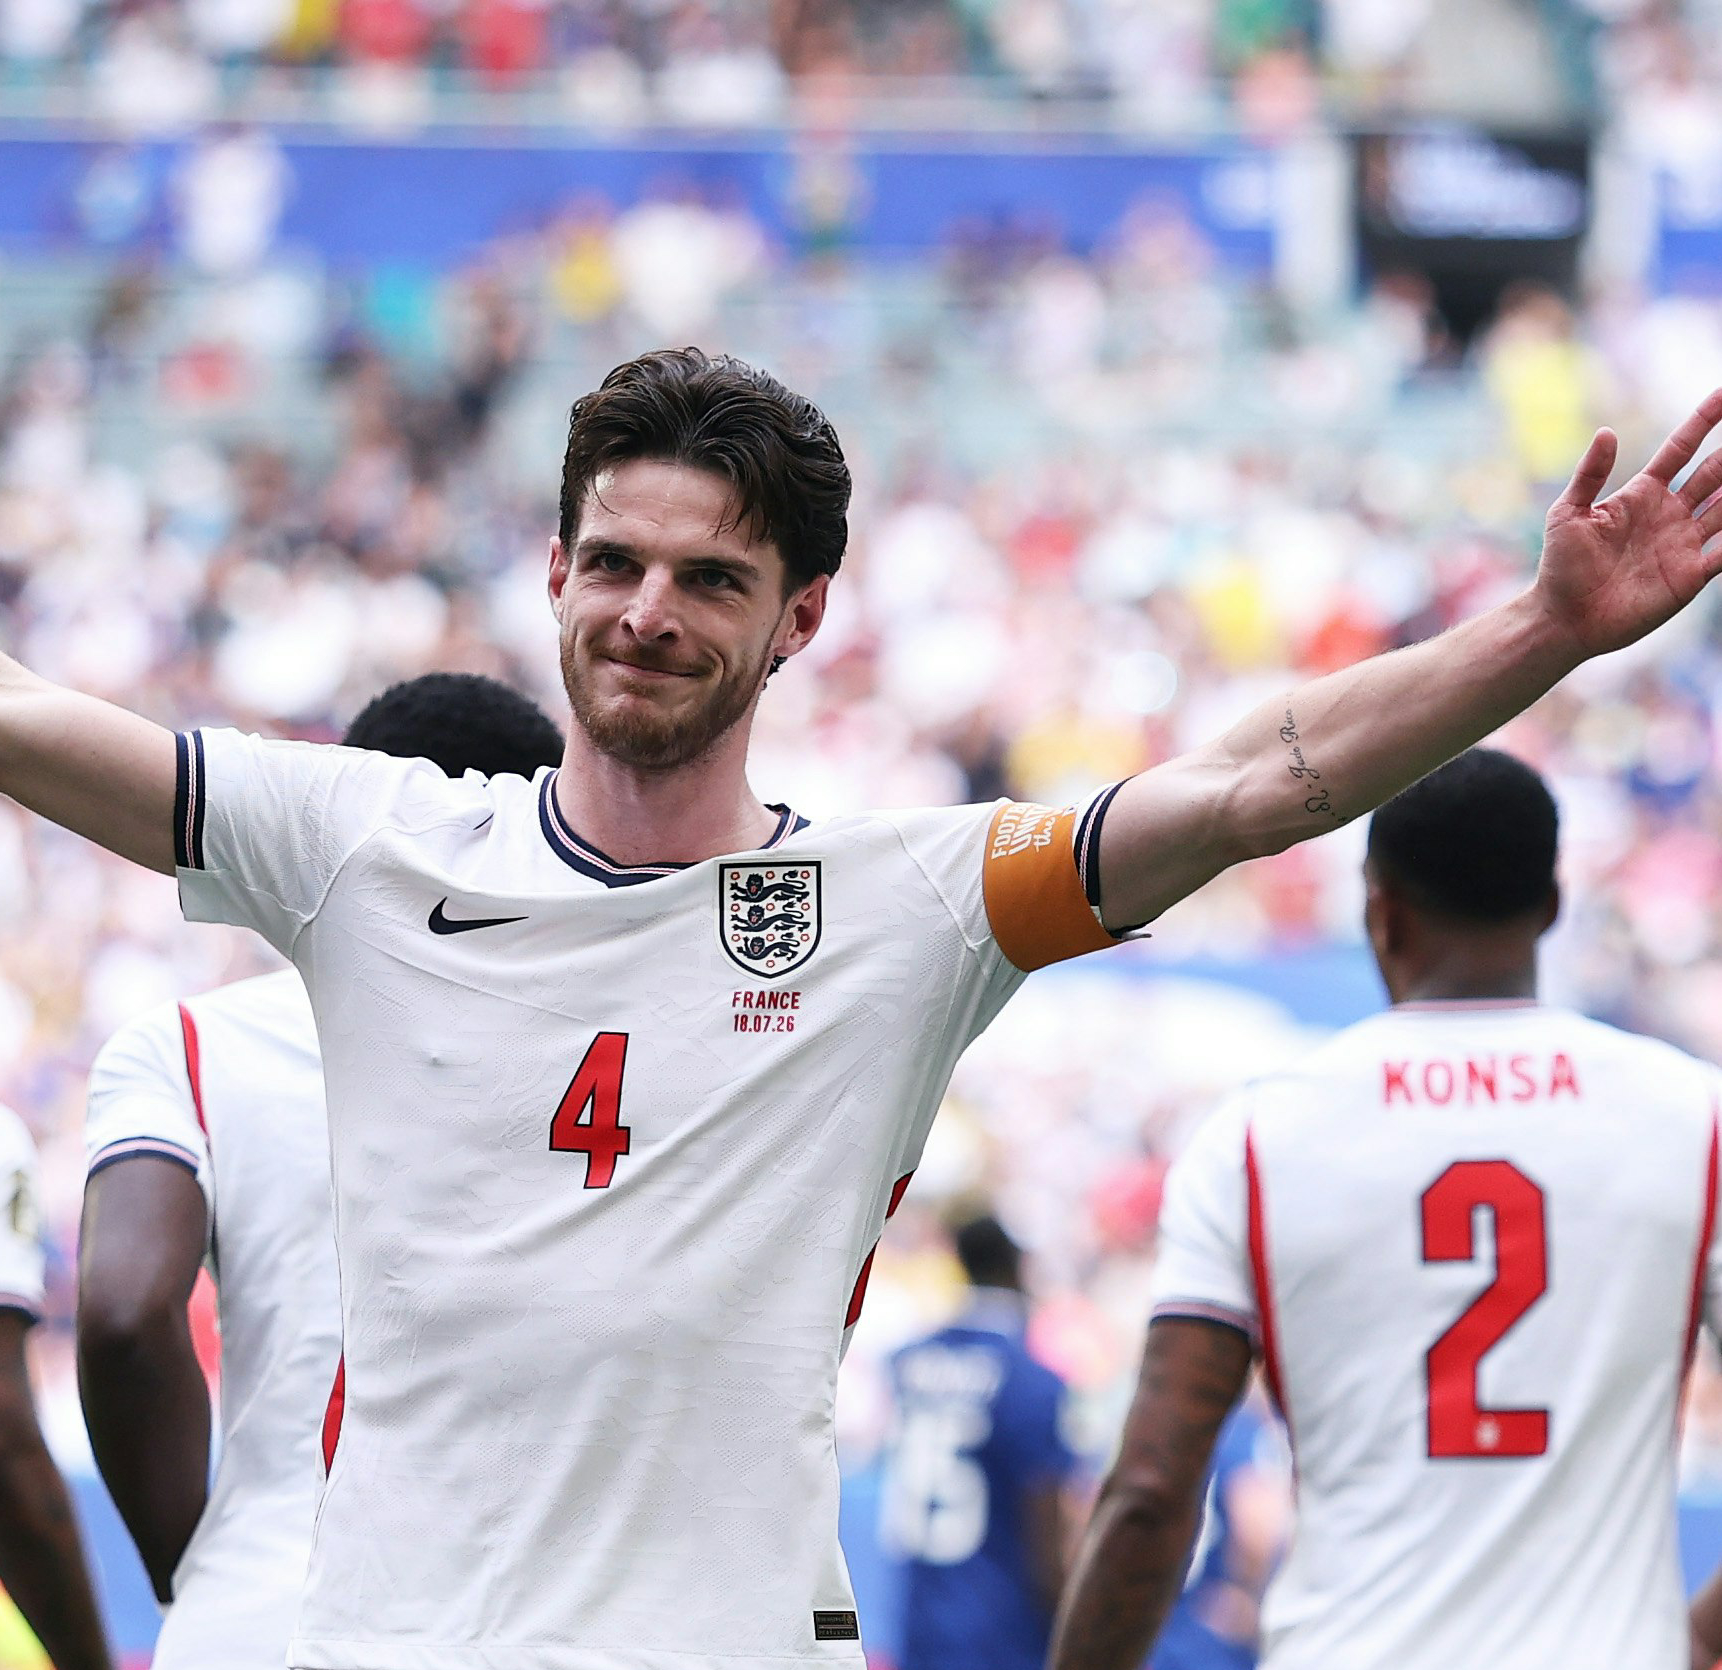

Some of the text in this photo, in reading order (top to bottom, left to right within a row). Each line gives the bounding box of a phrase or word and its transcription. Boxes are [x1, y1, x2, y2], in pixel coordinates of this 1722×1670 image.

[732, 990, 801, 1009] FRANCE
[733, 1013, 795, 1033] 18.07.26
[1382, 1053, 1582, 1104] KONSA
[549, 1031, 630, 1189] 4
[1420, 1159, 1548, 1459] 2
